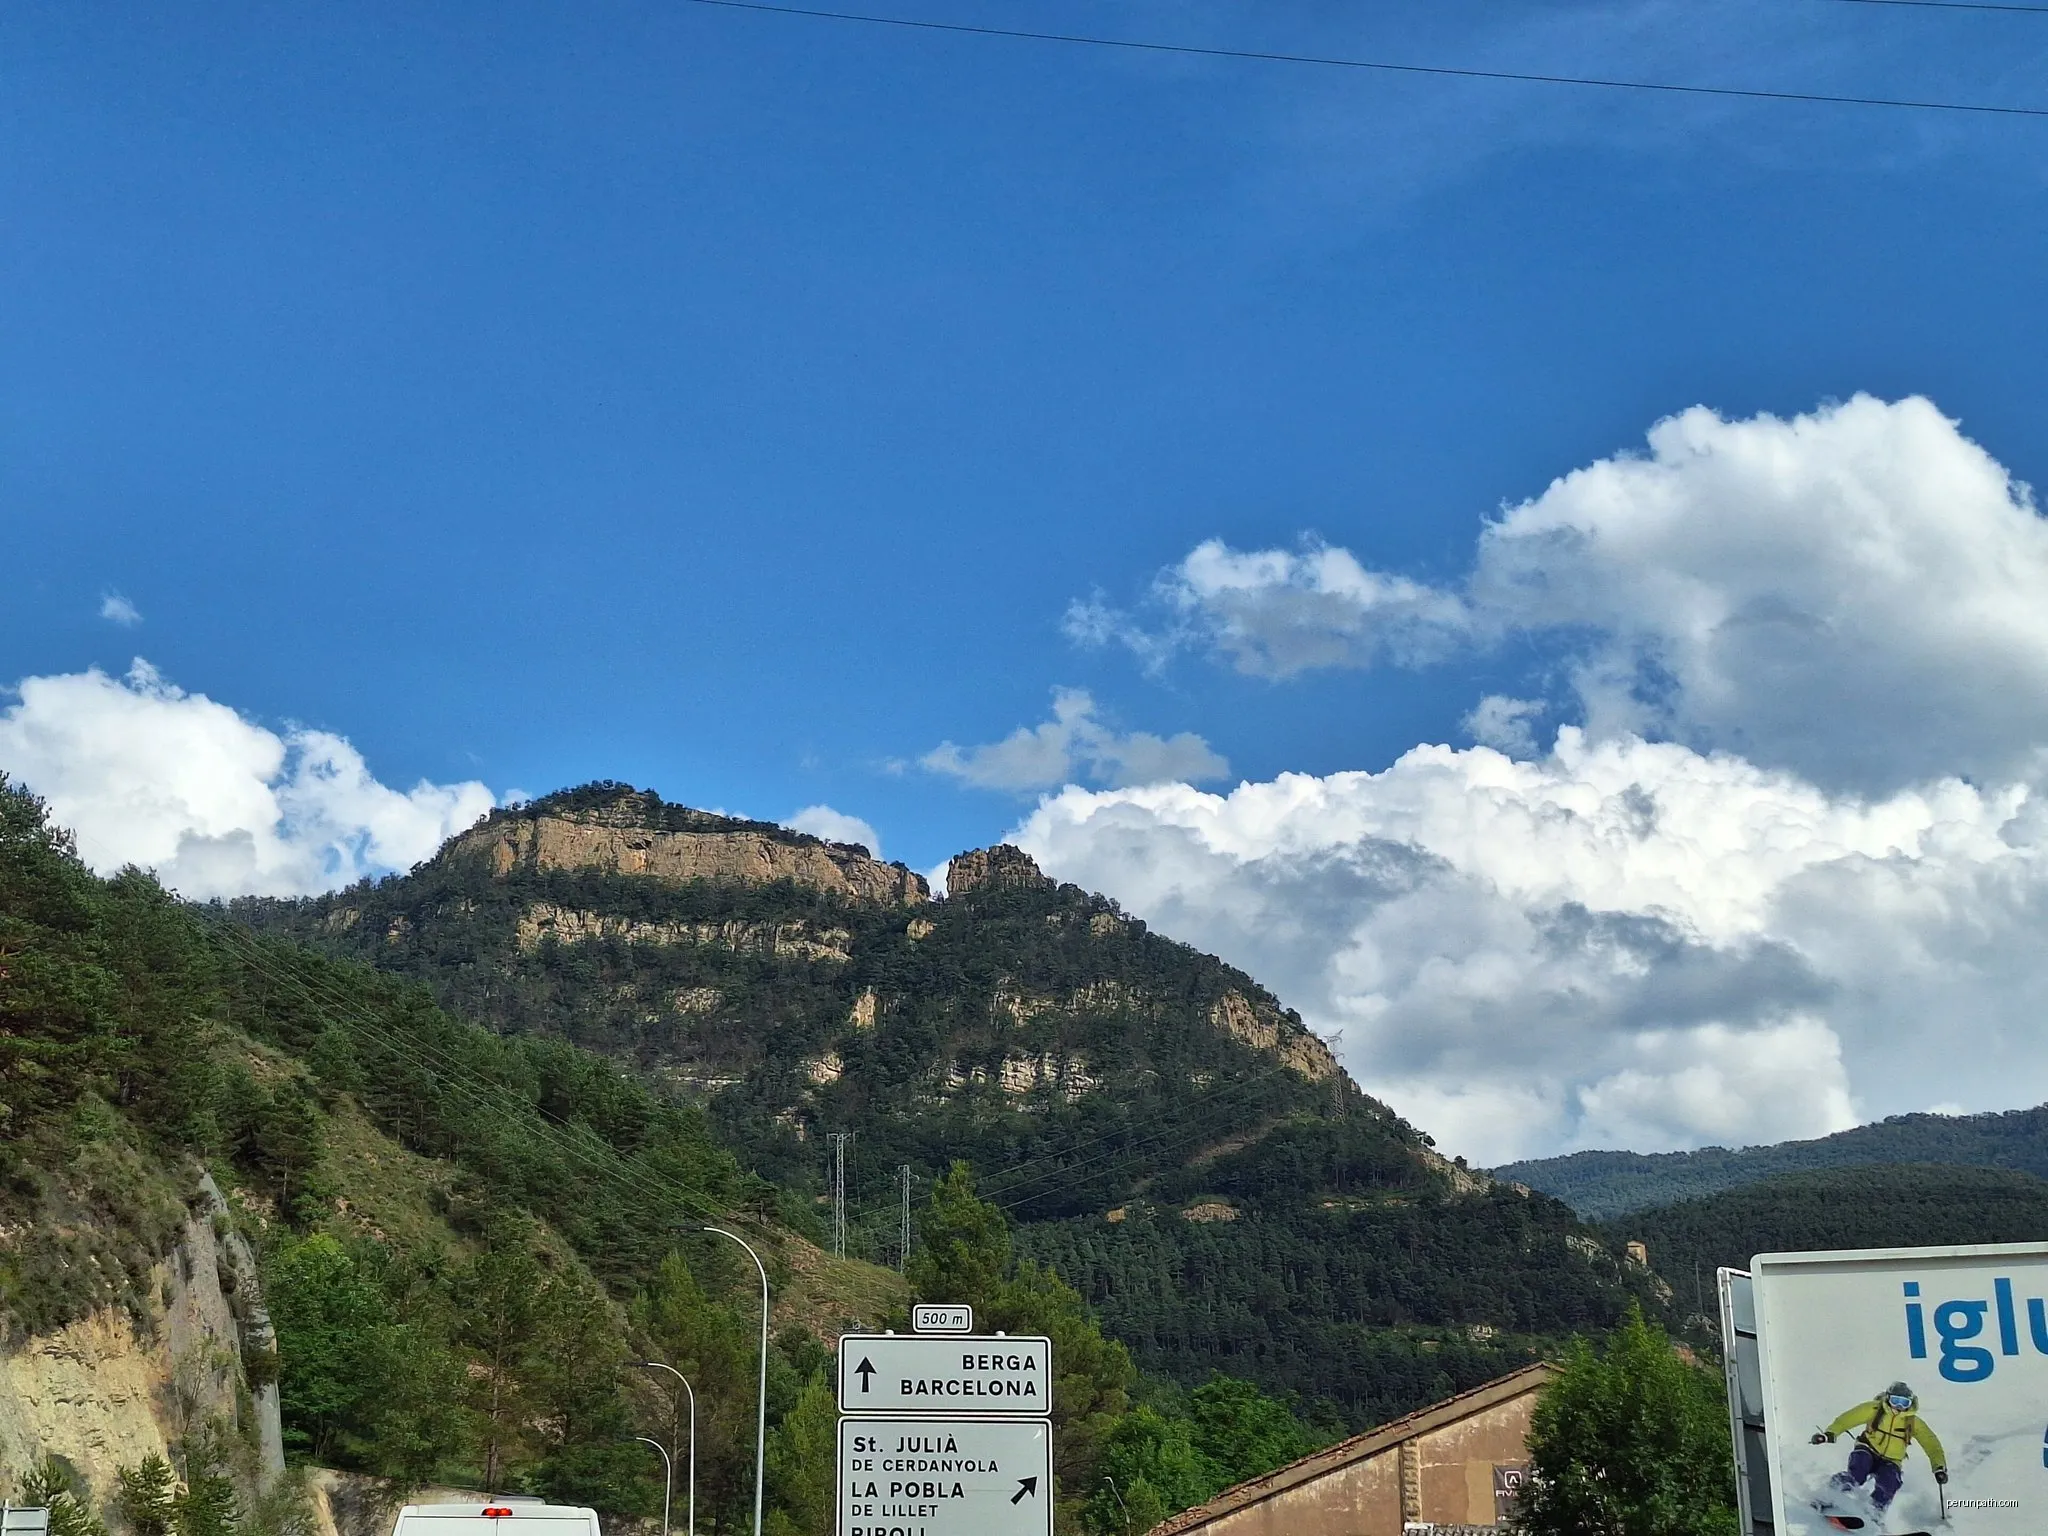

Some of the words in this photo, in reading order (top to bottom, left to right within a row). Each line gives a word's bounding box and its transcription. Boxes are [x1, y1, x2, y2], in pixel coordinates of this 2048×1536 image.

[922, 1312, 948, 1325] 500
[952, 1315, 963, 1325] m
[962, 1354, 1037, 1371] BERGA
[900, 1379, 1037, 1397] BARCELONA
[853, 1436, 884, 1453] St.
[896, 1433, 958, 1453] JULIÀ
[852, 1459, 873, 1472] DE
[882, 1459, 999, 1473] CERDANYOLA
[851, 1481, 879, 1498] LA
[890, 1481, 965, 1499] POBLA
[851, 1504, 873, 1517] DE
[882, 1504, 939, 1518] LILLET
